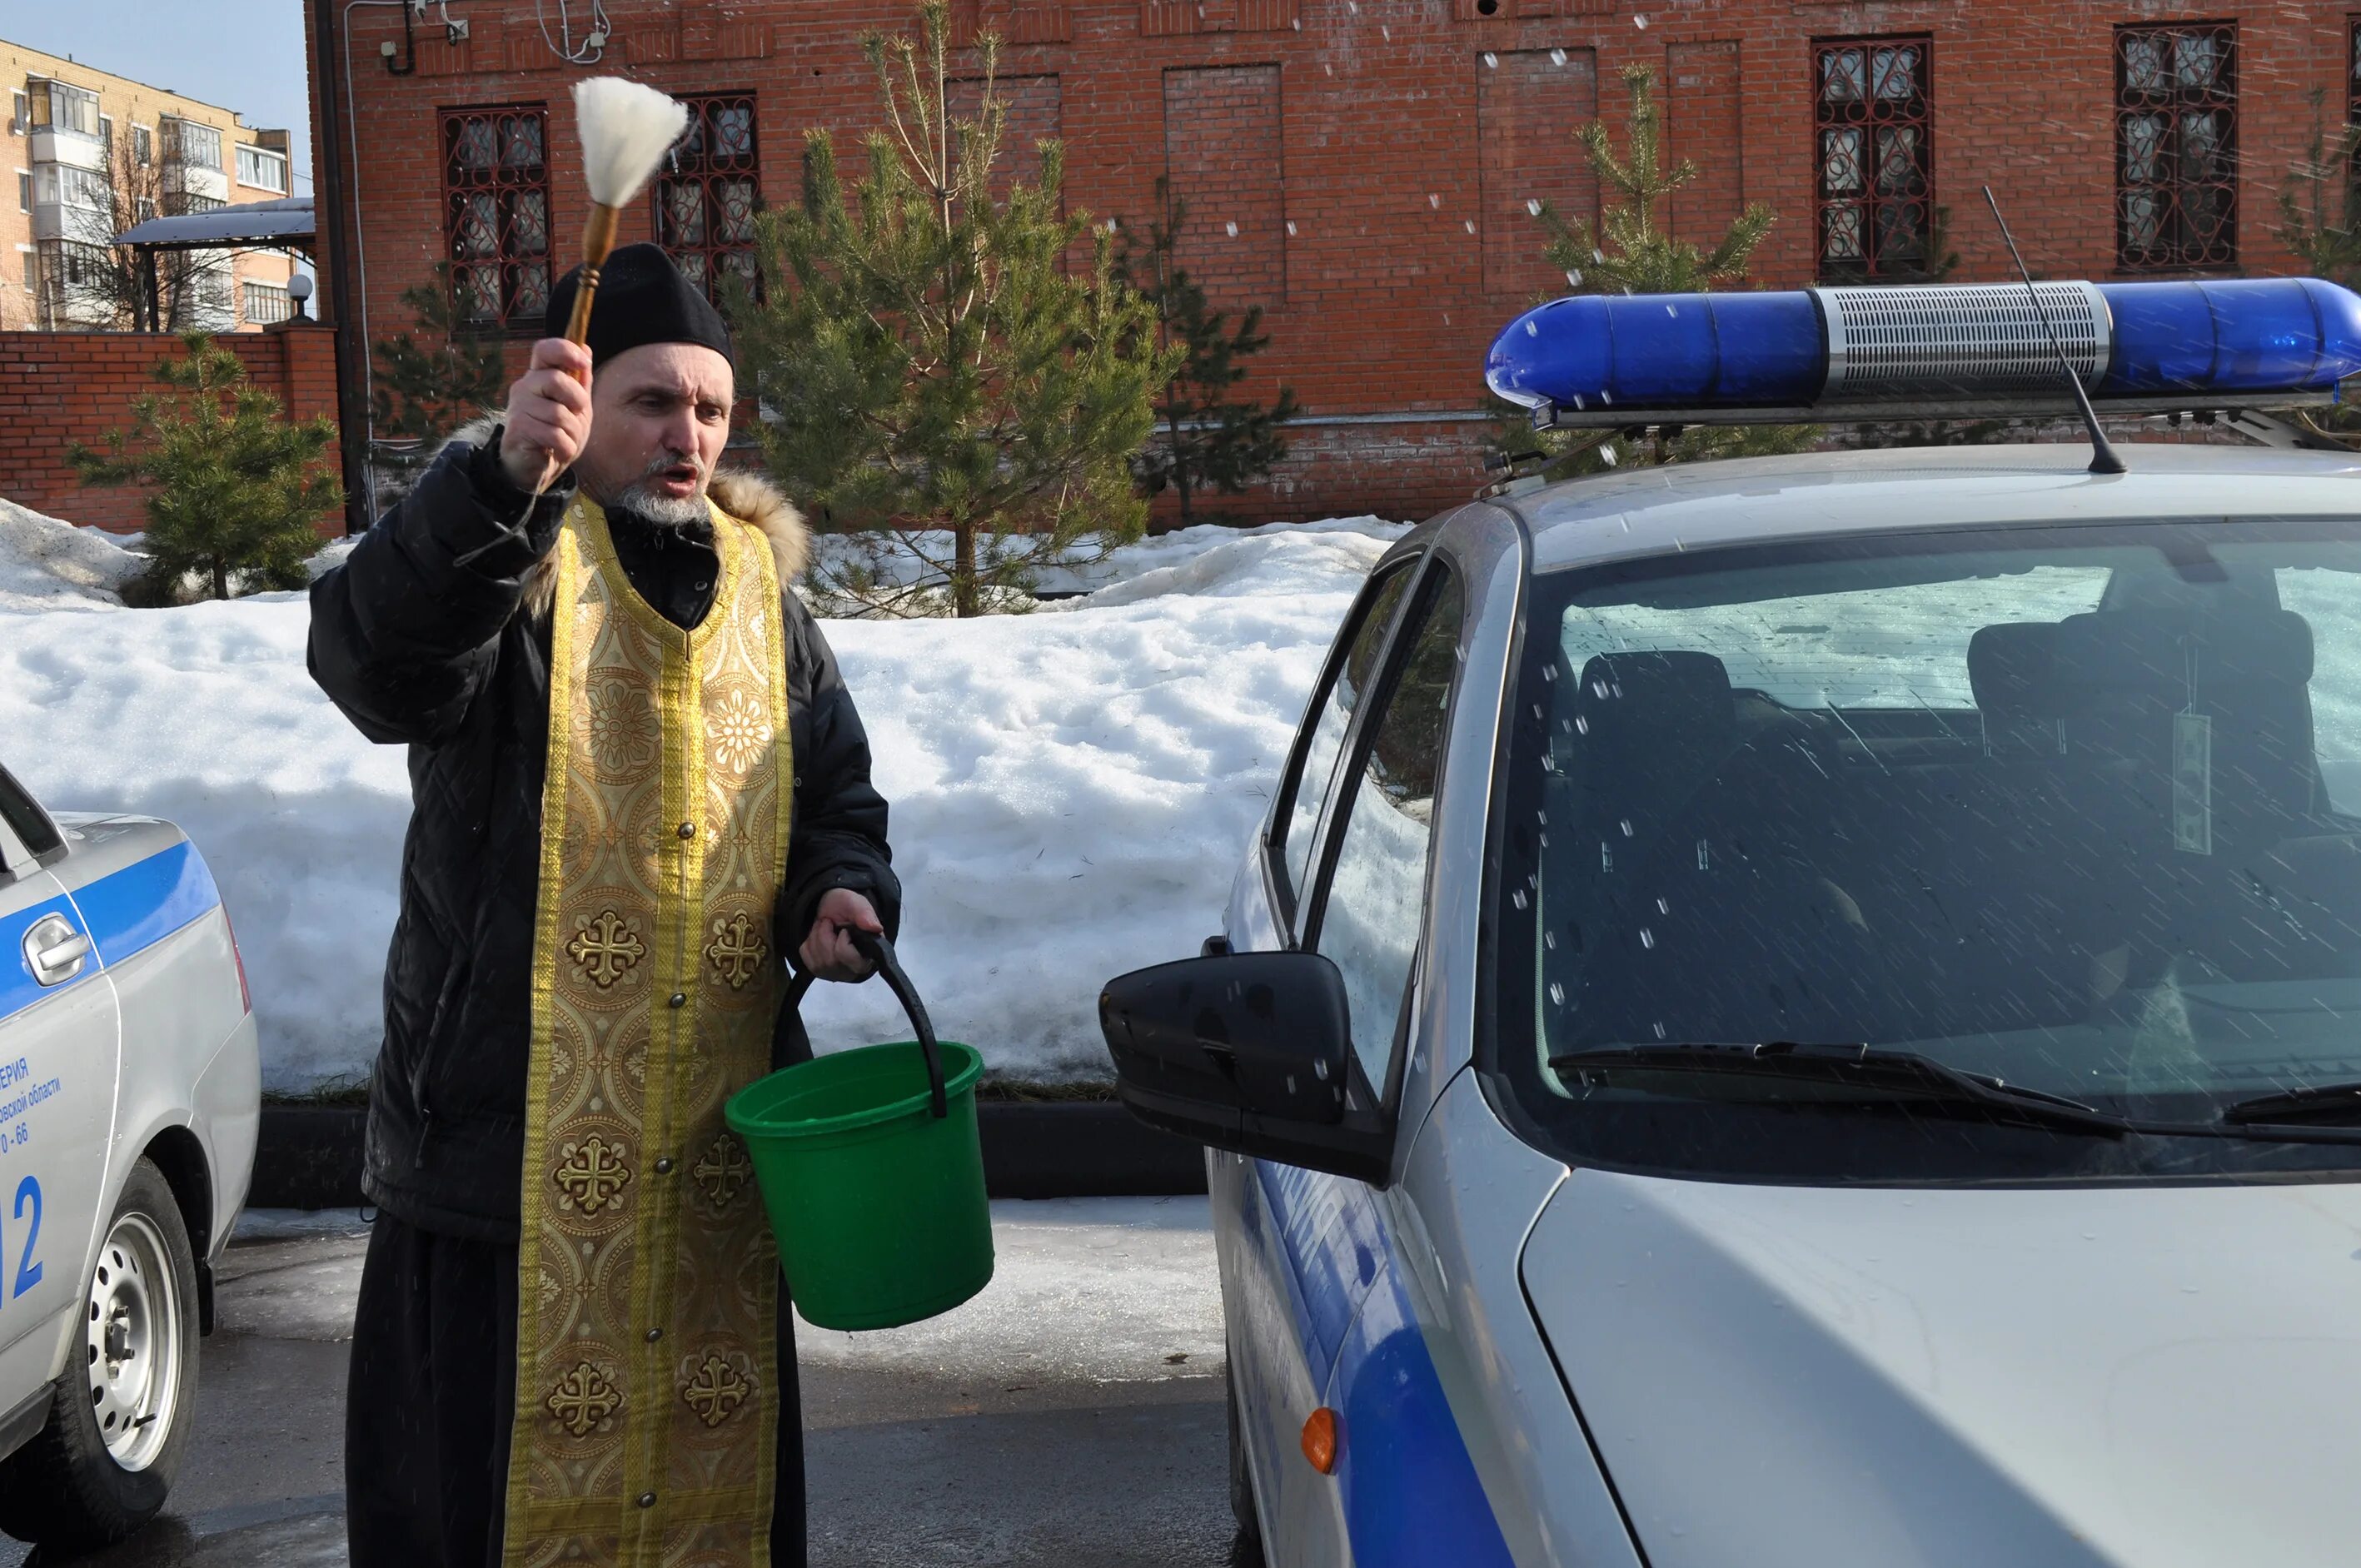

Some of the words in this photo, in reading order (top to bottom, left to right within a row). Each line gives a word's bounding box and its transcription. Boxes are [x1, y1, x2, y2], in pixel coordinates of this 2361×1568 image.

[0, 1058, 29, 1090] ЕРИЯ
[28, 1078, 61, 1107] области
[16, 1122, 28, 1145] 66
[0, 1176, 42, 1309] 2
